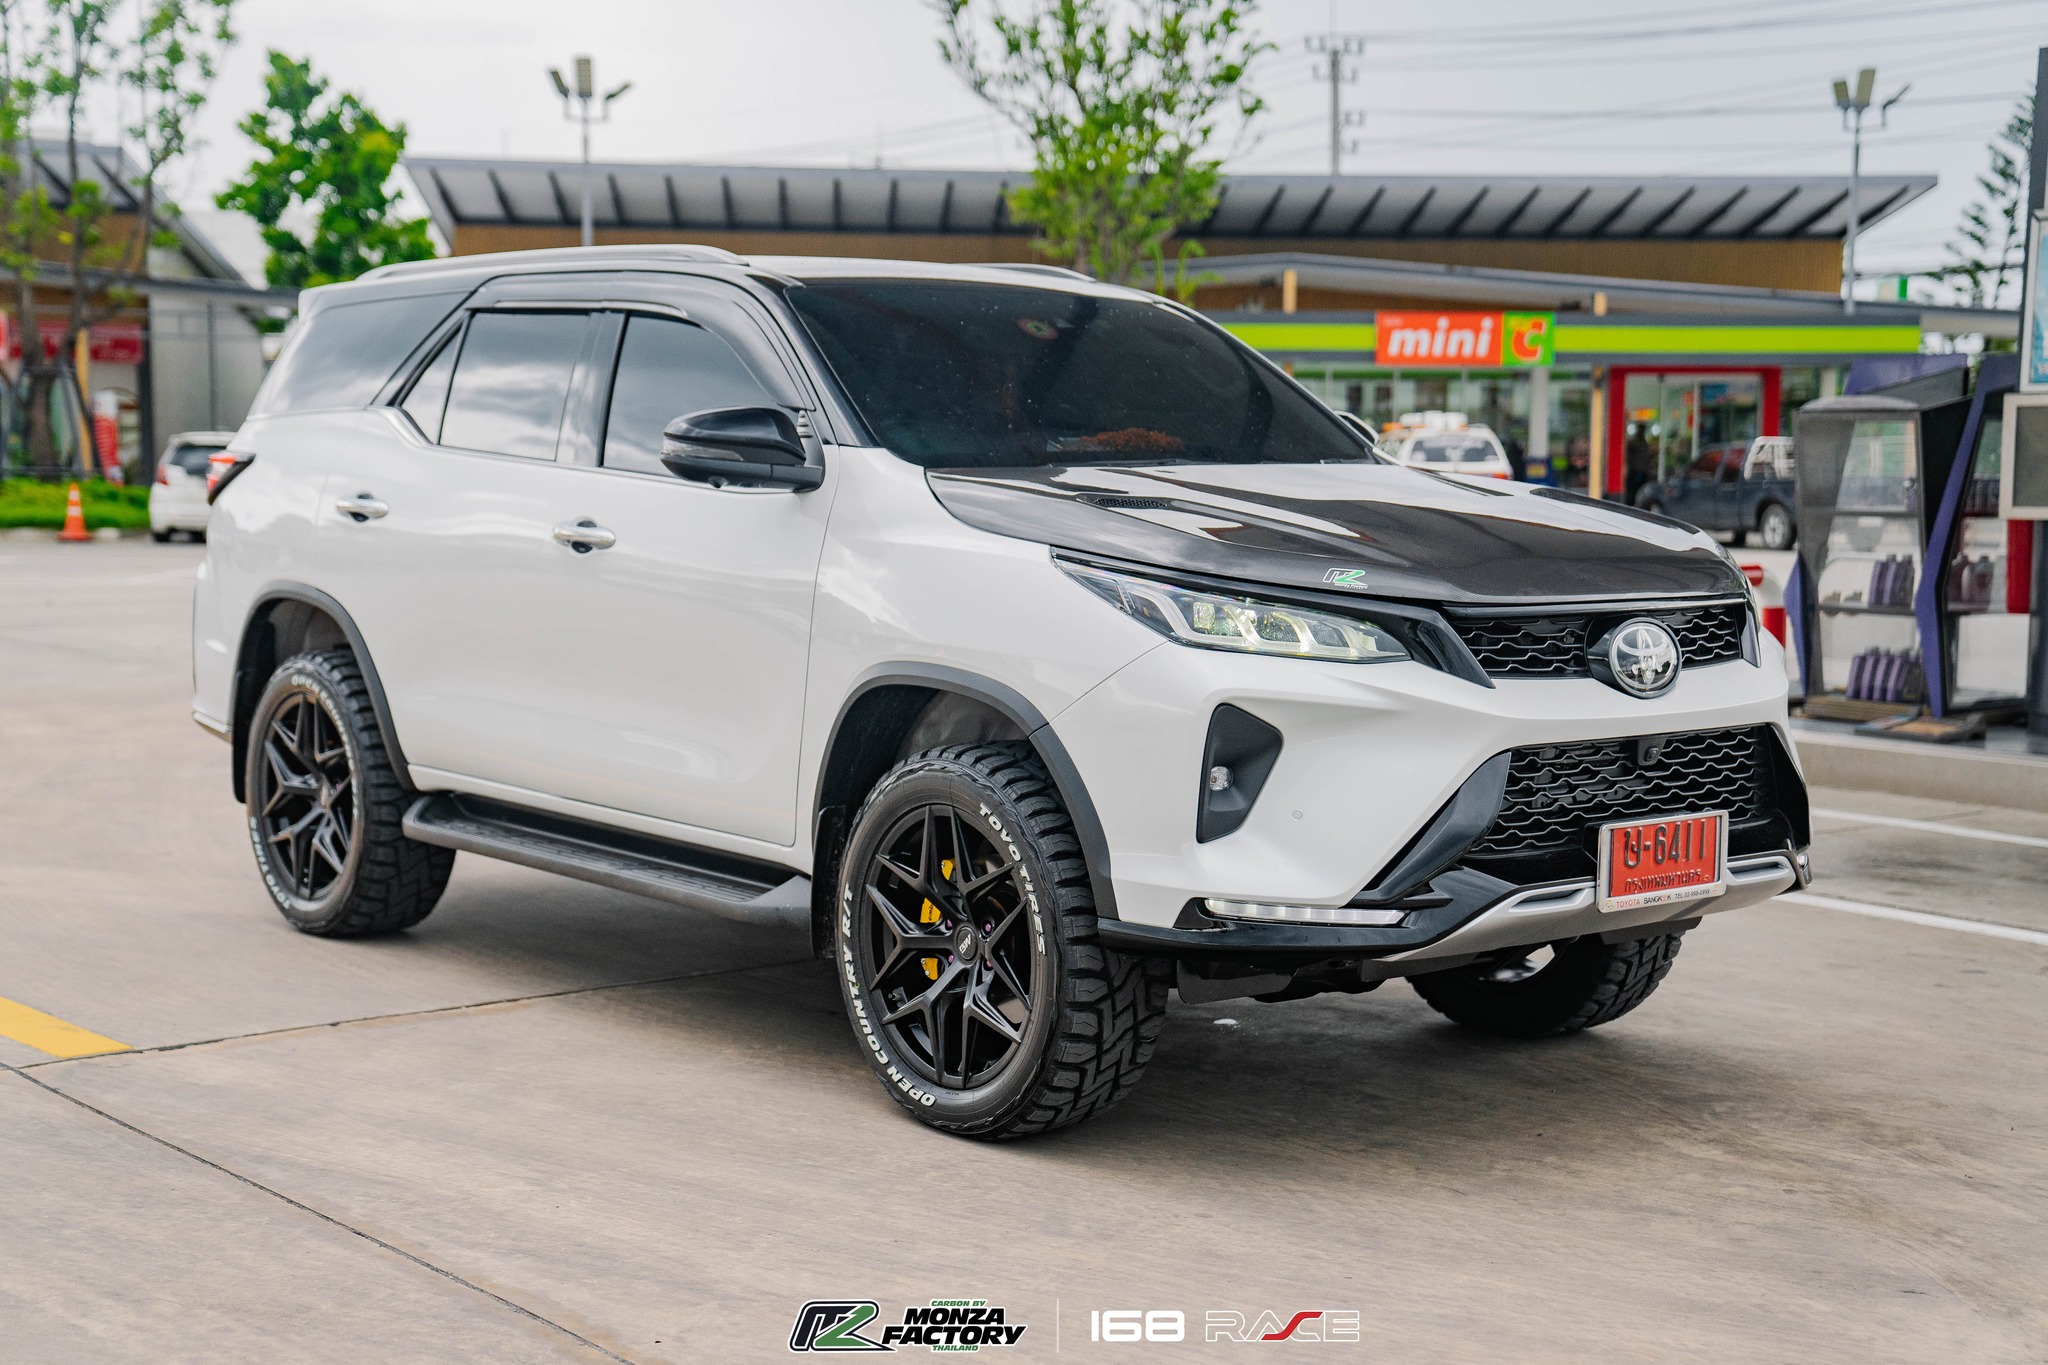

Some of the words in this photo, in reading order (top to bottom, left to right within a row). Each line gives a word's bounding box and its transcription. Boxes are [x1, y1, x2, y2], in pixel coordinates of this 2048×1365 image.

[1387, 316, 1495, 358] mini
[979, 802, 1022, 862] TOYO
[1019, 864, 1046, 955] TIRES
[842, 881, 853, 938] R/T
[1616, 898, 1641, 909] TOYOTA
[843, 942, 889, 1065] COUNTRY
[886, 1065, 936, 1106] OPEN
